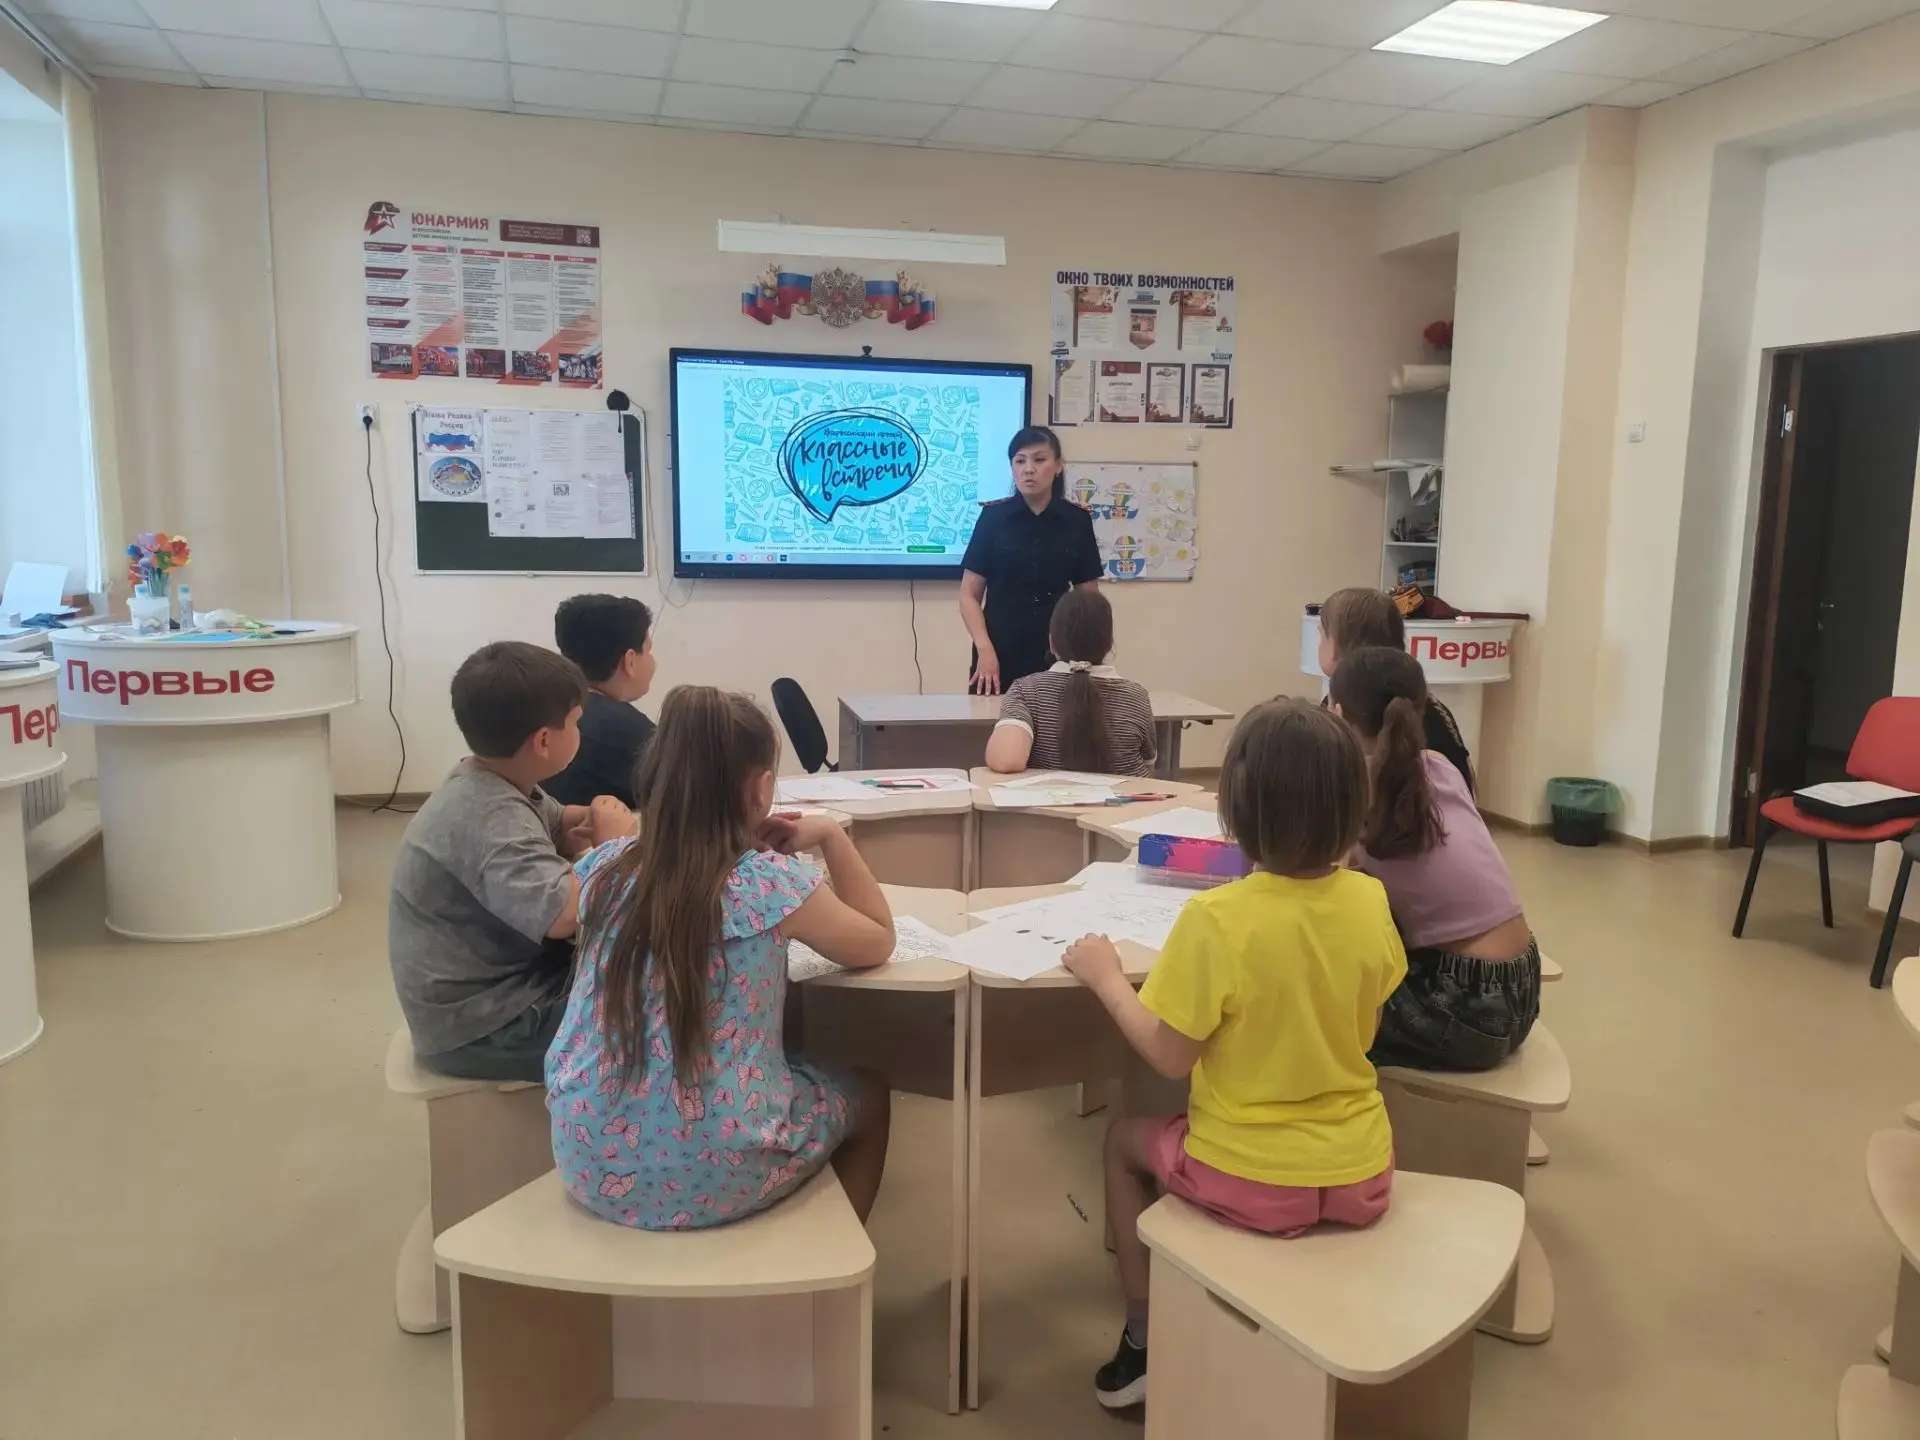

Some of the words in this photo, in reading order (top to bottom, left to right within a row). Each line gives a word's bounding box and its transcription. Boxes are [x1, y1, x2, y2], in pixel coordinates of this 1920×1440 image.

[412, 213, 488, 230] ЮНАРМИЯ
[1057, 271, 1089, 285] ОКНО
[1094, 272, 1133, 287] ТВОИХ
[1138, 275, 1235, 291] ВОЗМОЖНОСТЕЙ
[67, 659, 275, 706] Первые
